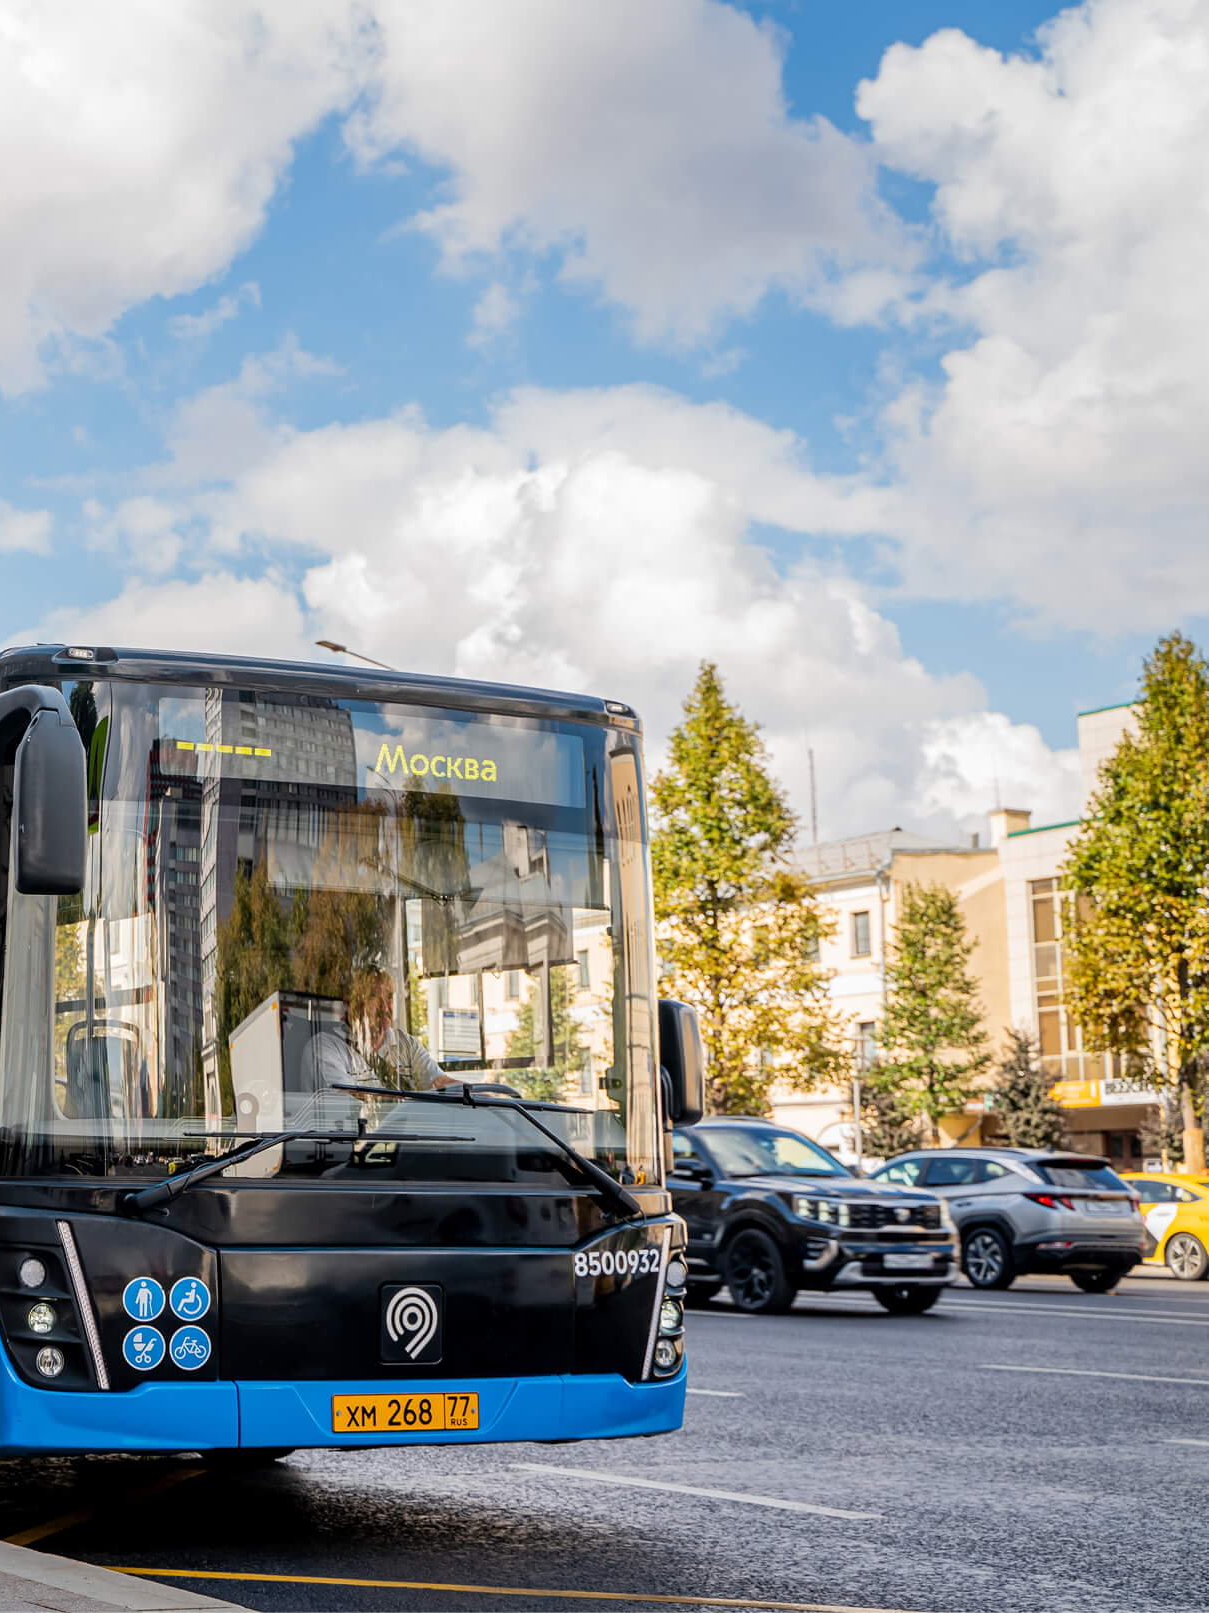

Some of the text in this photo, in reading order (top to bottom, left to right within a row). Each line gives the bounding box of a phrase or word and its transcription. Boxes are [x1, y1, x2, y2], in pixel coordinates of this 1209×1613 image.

[375, 743, 497, 782] Москва
[574, 1249, 659, 1277] 8500932
[388, 1398, 432, 1426] 268
[447, 1396, 470, 1417] 77
[451, 1418, 468, 1426] RUS
